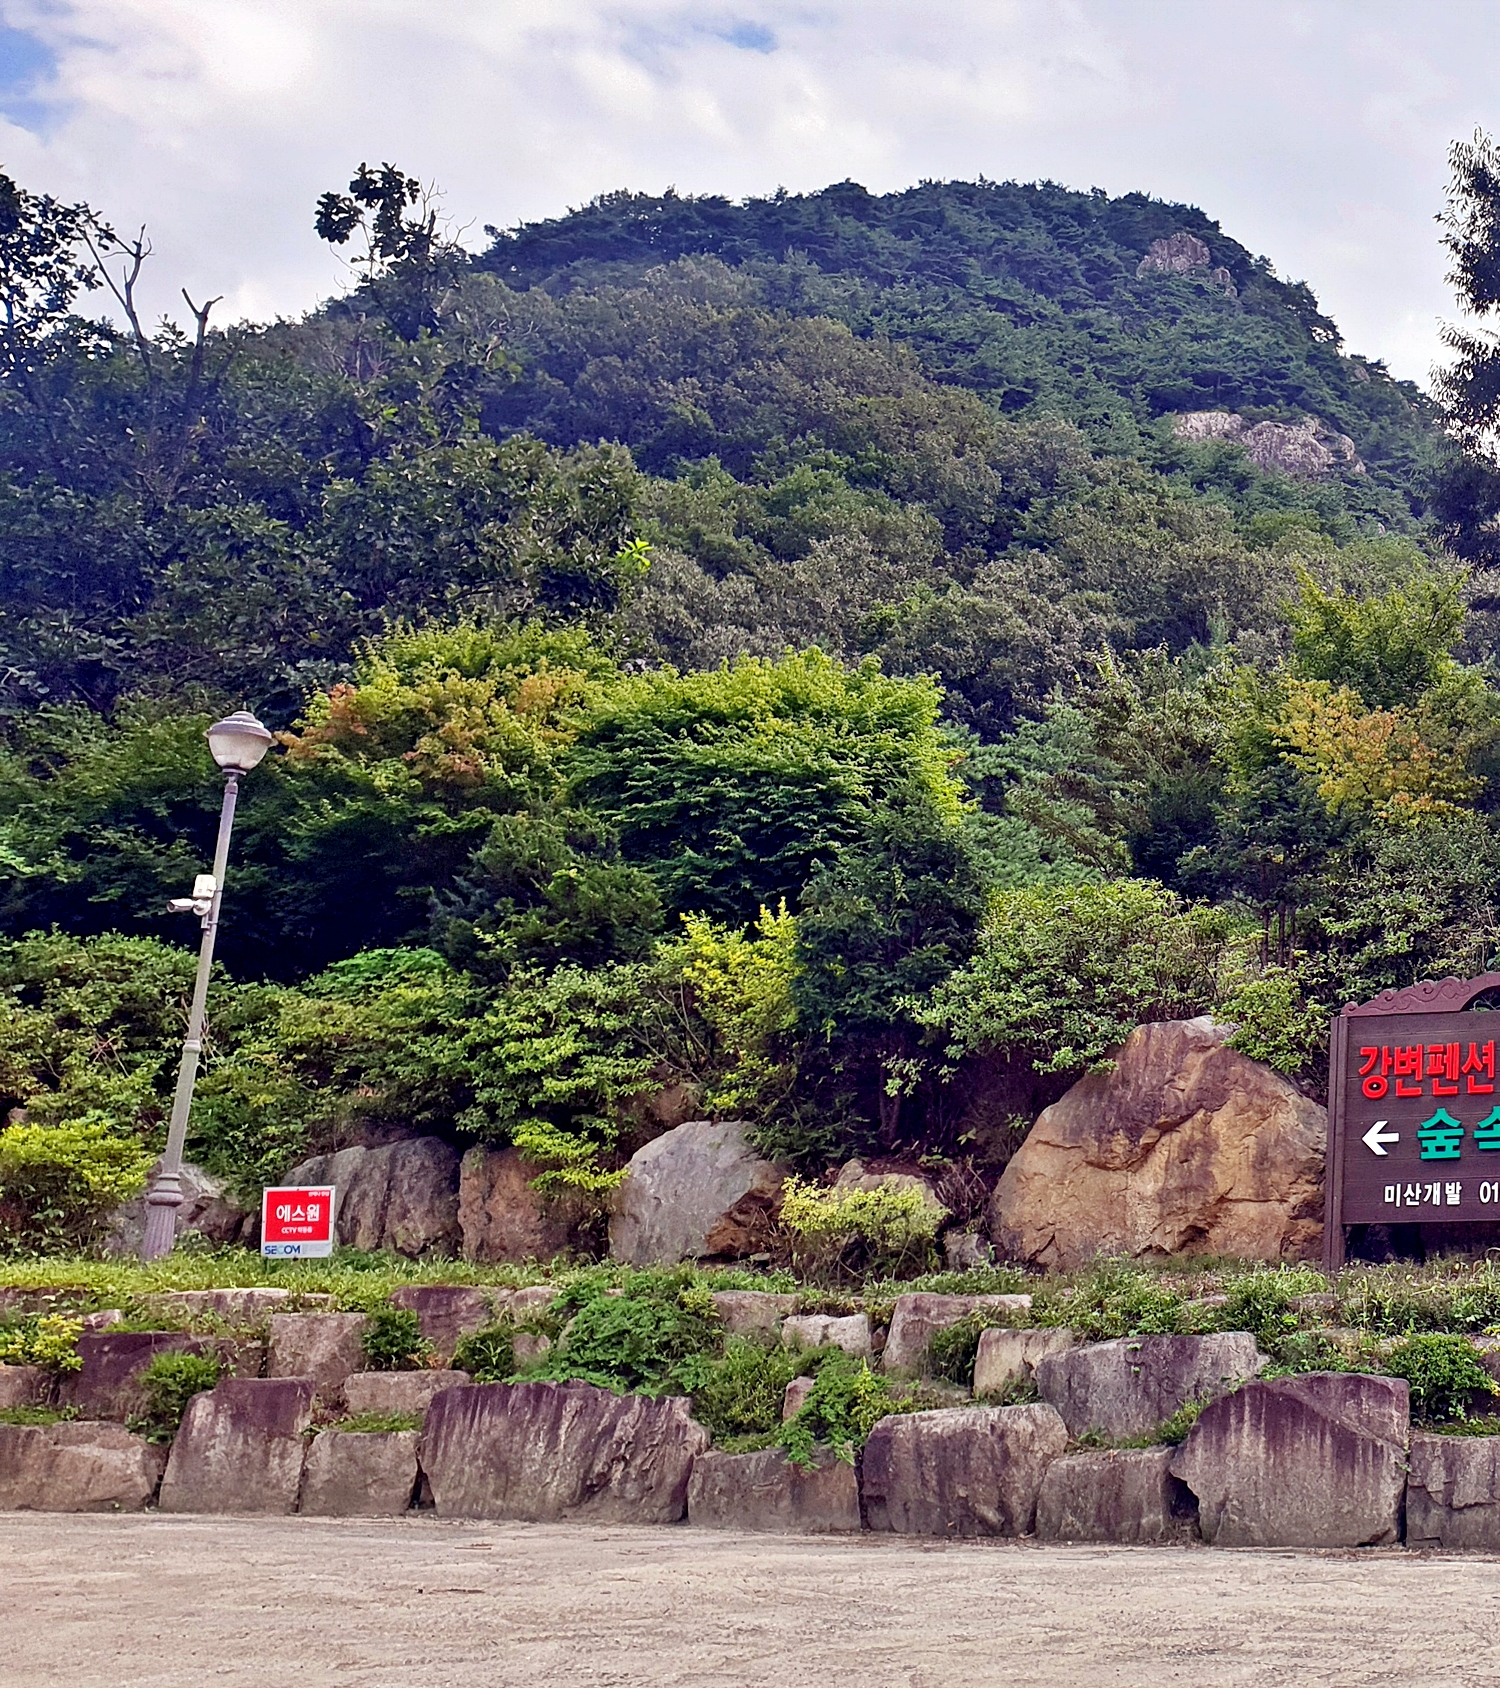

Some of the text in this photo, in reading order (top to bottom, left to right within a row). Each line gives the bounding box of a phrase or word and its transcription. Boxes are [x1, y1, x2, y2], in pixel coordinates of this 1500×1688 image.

[1384, 1181, 1462, 1207] 미산개발
[276, 1203, 320, 1222] 에스원
[281, 1226, 297, 1234] CCTV
[264, 1245, 300, 1254] SECOM
